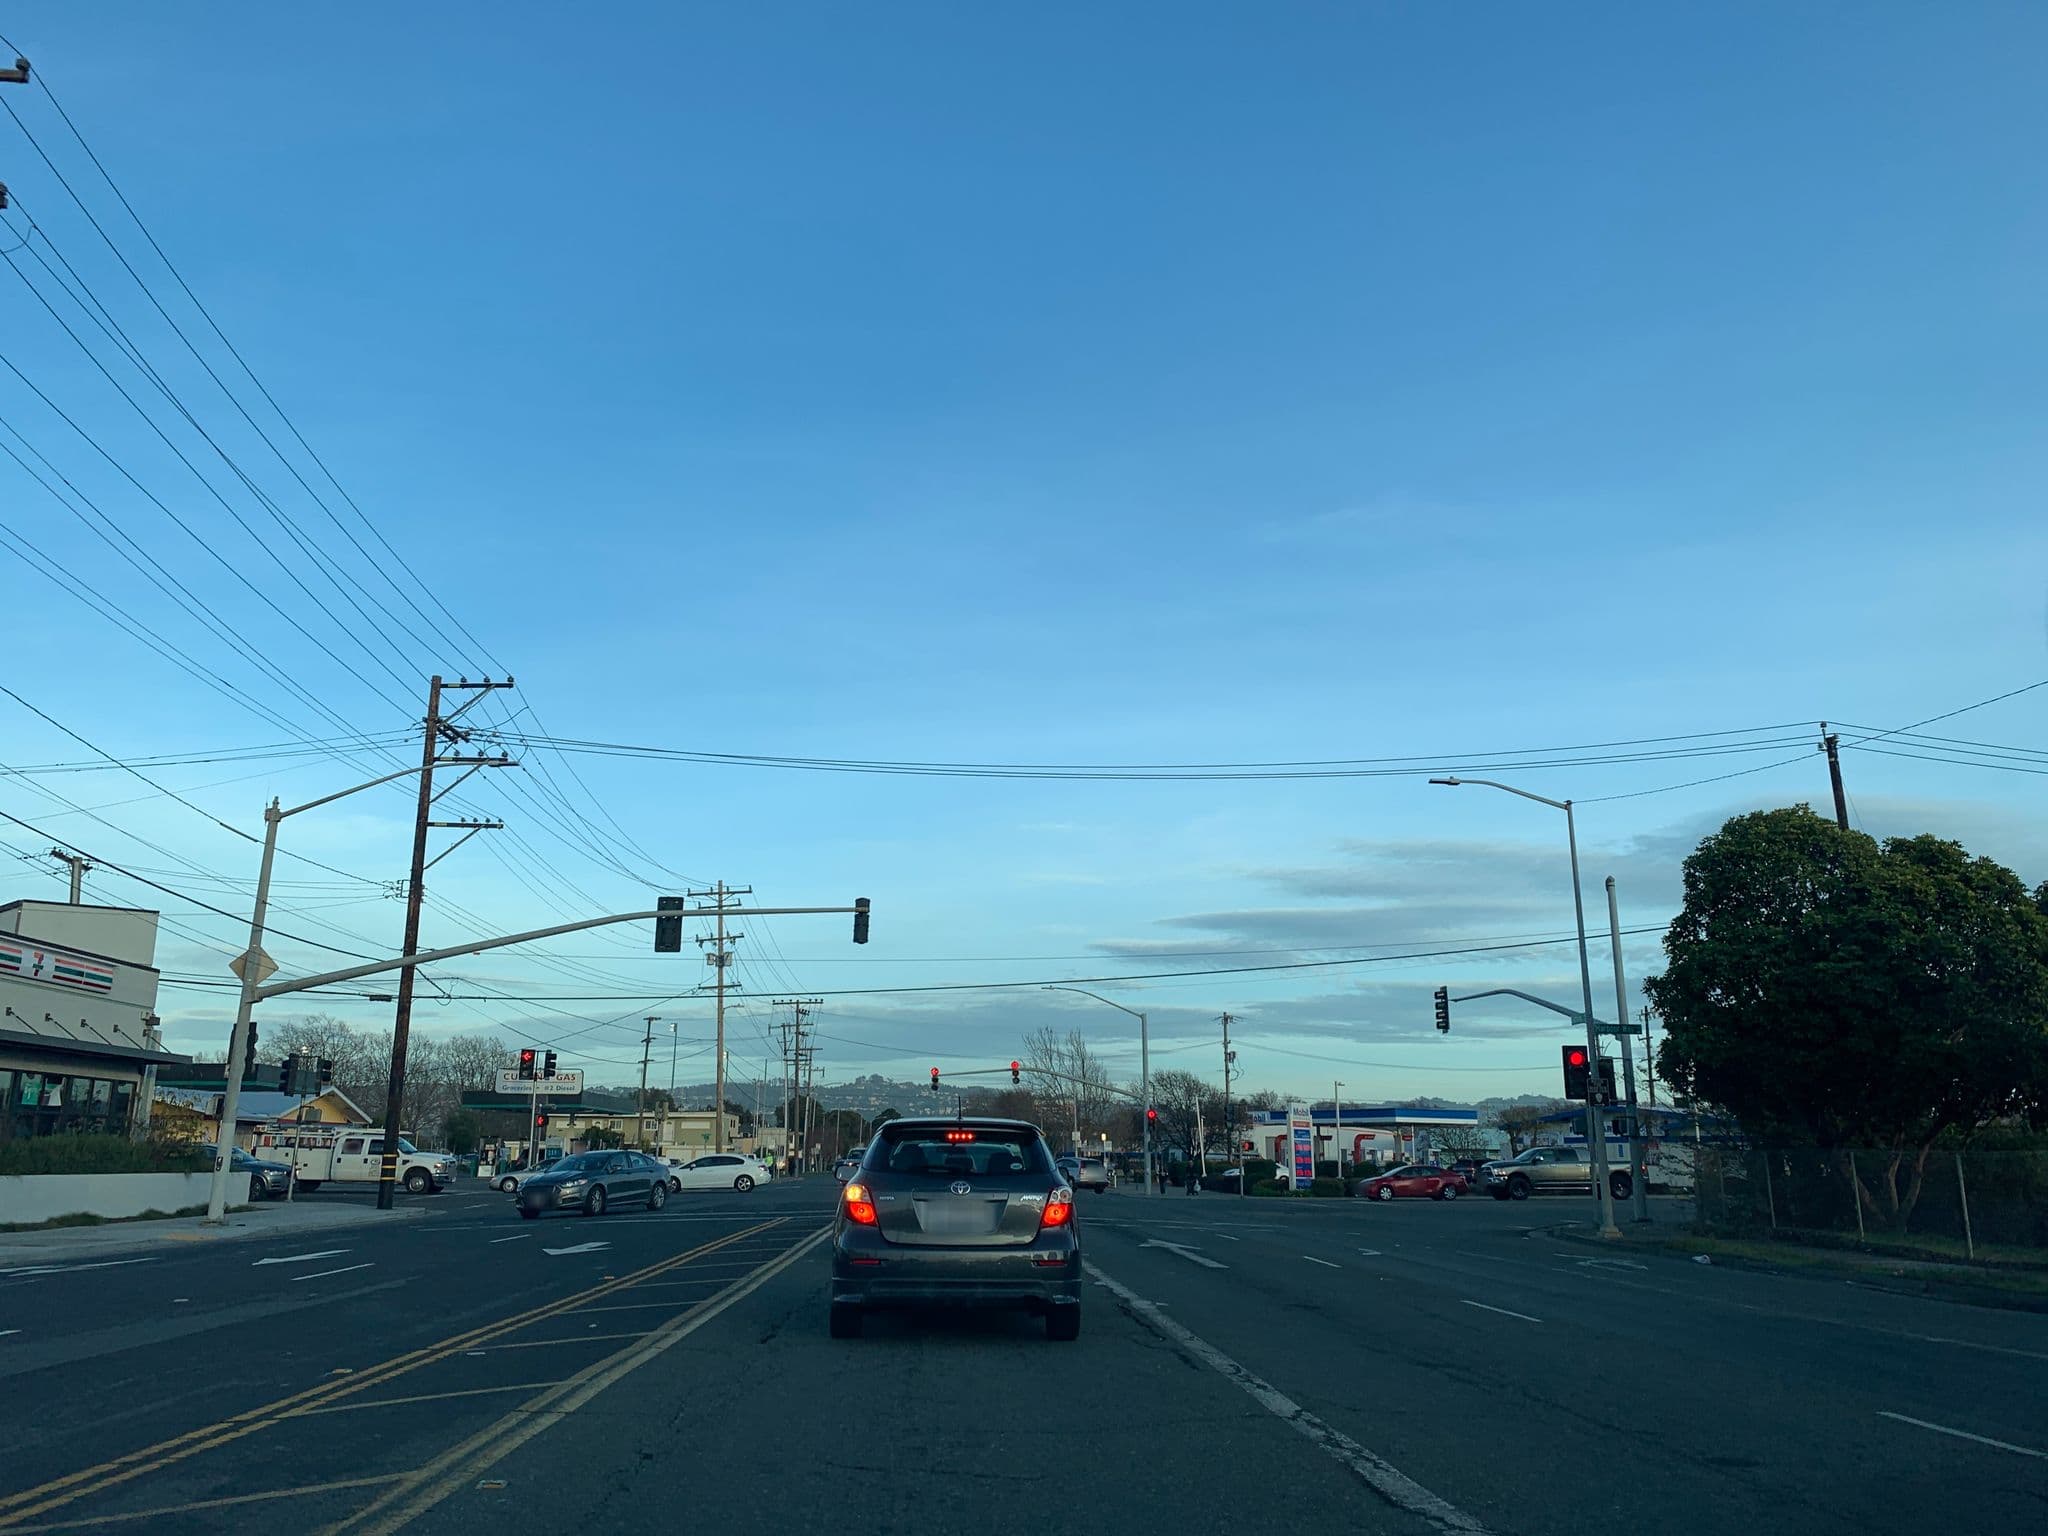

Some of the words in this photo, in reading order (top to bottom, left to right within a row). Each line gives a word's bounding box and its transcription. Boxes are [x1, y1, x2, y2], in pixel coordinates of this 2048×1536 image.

[32, 950, 45, 977] 7
[556, 1073, 576, 1082] GAS
[502, 1084, 532, 1092] Groceries
